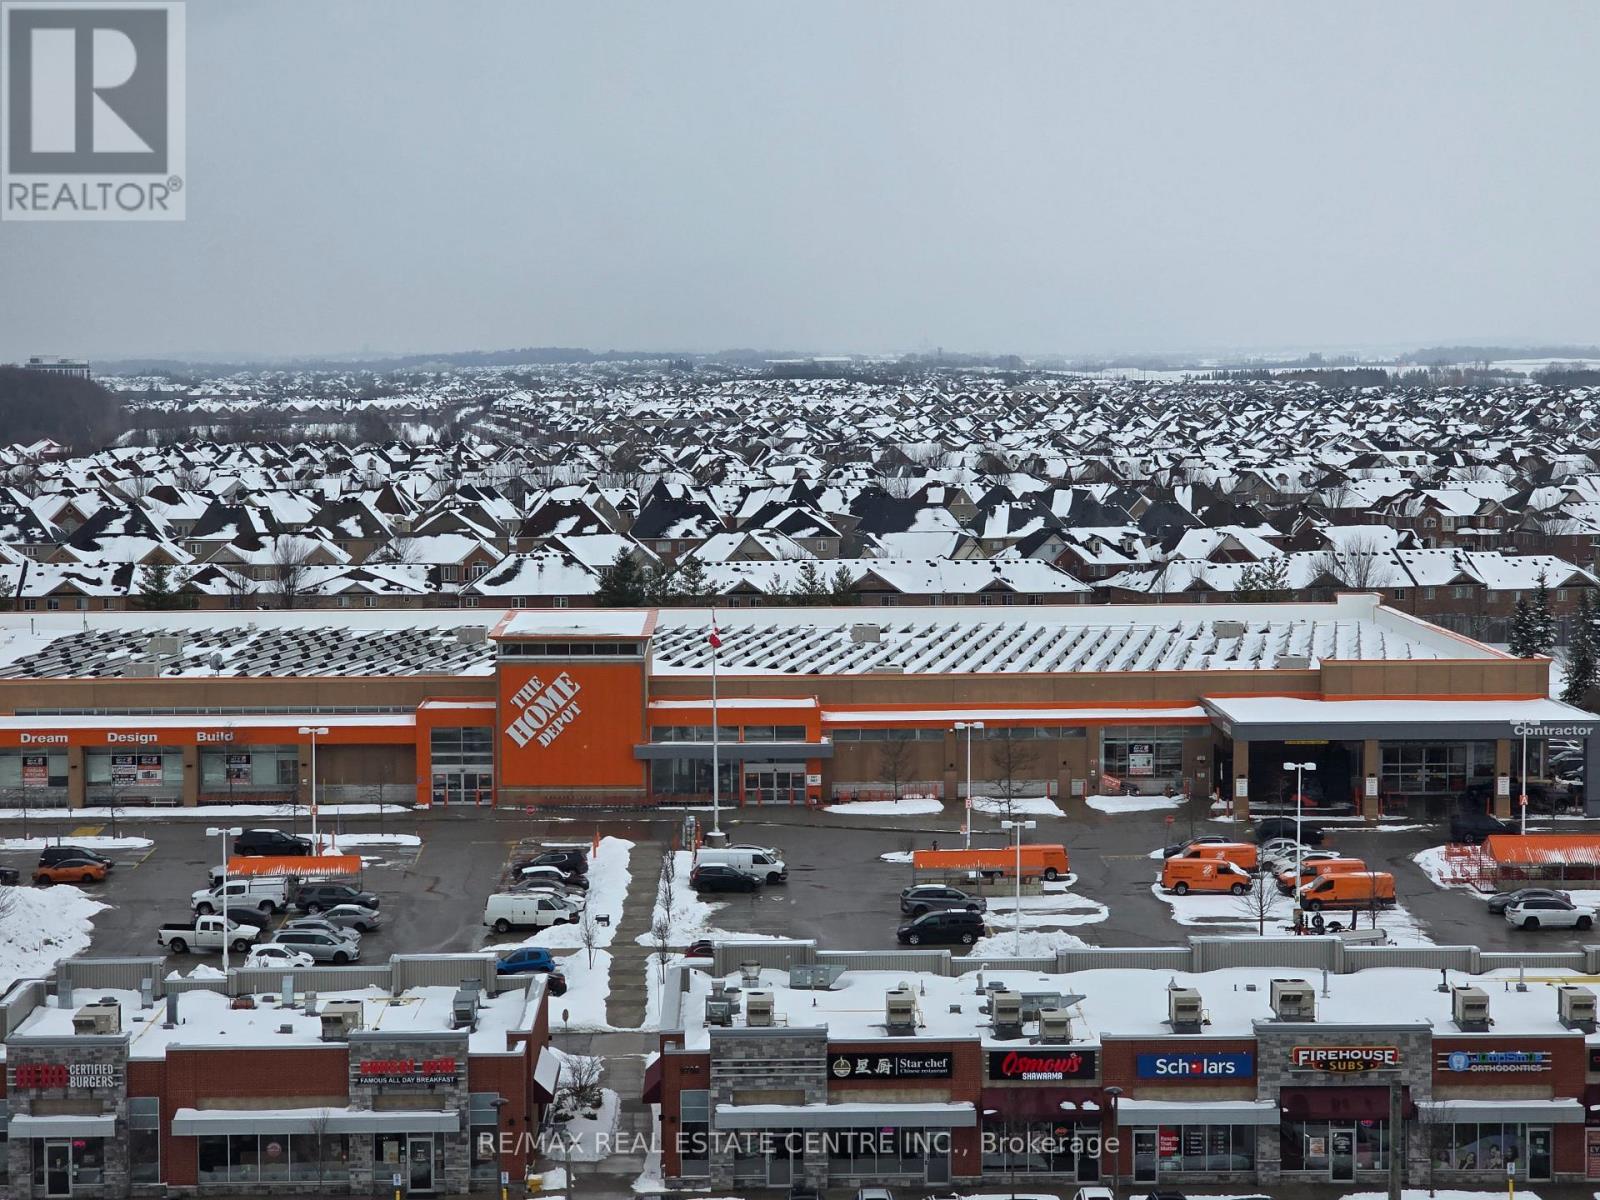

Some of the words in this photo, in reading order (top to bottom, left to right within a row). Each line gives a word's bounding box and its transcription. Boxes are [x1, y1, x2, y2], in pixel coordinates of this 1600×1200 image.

[510, 675, 545, 709] THE
[505, 671, 581, 748] HOME
[536, 700, 582, 748] DEPOT
[1513, 725, 1594, 736] Contractor
[20, 733, 68, 744] Dream
[107, 732, 158, 744] Design
[196, 731, 234, 742] Build
[899, 1058, 924, 1068] Star
[925, 1058, 948, 1068] chef
[1298, 1050, 1395, 1066] FIREHOUSE
[69, 1064, 114, 1075] CERTIFIED
[1329, 1061, 1364, 1070] SUBS
[1022, 1072, 1063, 1080] SHAWARMA
[69, 1076, 114, 1088] BURGERS
